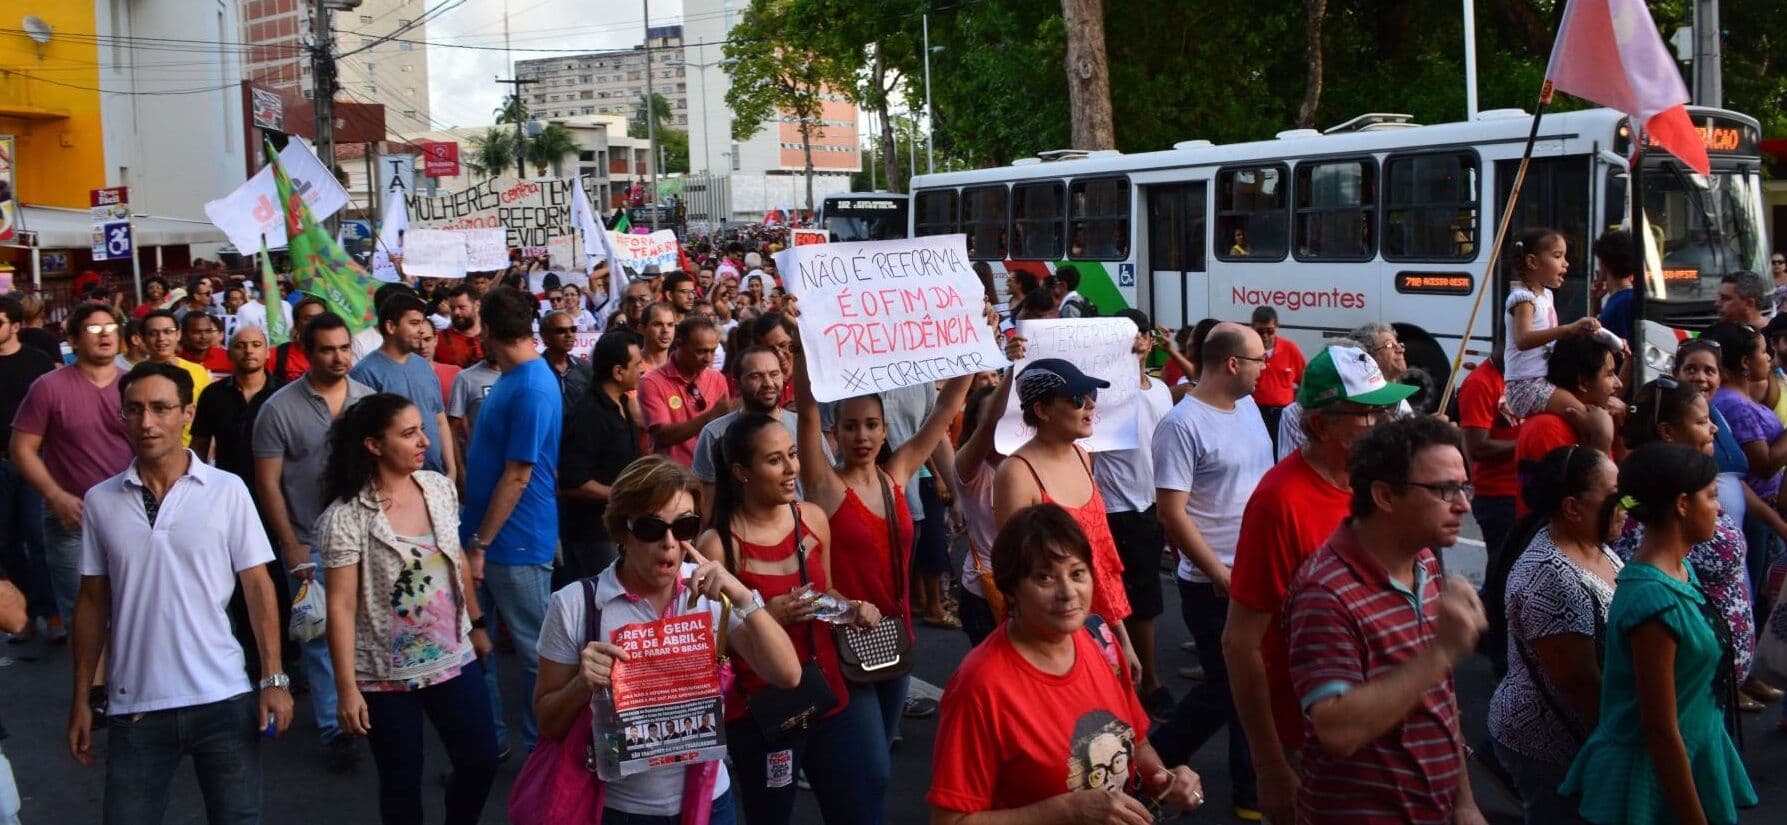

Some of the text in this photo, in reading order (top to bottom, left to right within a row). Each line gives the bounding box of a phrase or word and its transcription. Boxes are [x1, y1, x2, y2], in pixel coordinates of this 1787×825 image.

[403, 176, 500, 222] MULHERES
[501, 180, 539, 204] contra
[498, 205, 572, 228] REFORM
[795, 232, 827, 246] FORA
[799, 248, 966, 290] NÃO É REFORMA
[836, 285, 965, 318] É O FIM DA
[1231, 286, 1365, 311] Navegantes
[823, 313, 980, 358] PREVIDÊNCIA
[840, 351, 990, 393] #FORATEMER
[663, 620, 706, 634] GERAL
[623, 641, 638, 651] 28
[642, 639, 658, 648] DE
[632, 651, 643, 659] DE
[645, 647, 670, 657] PARAR
[682, 643, 709, 653] BRASIL
